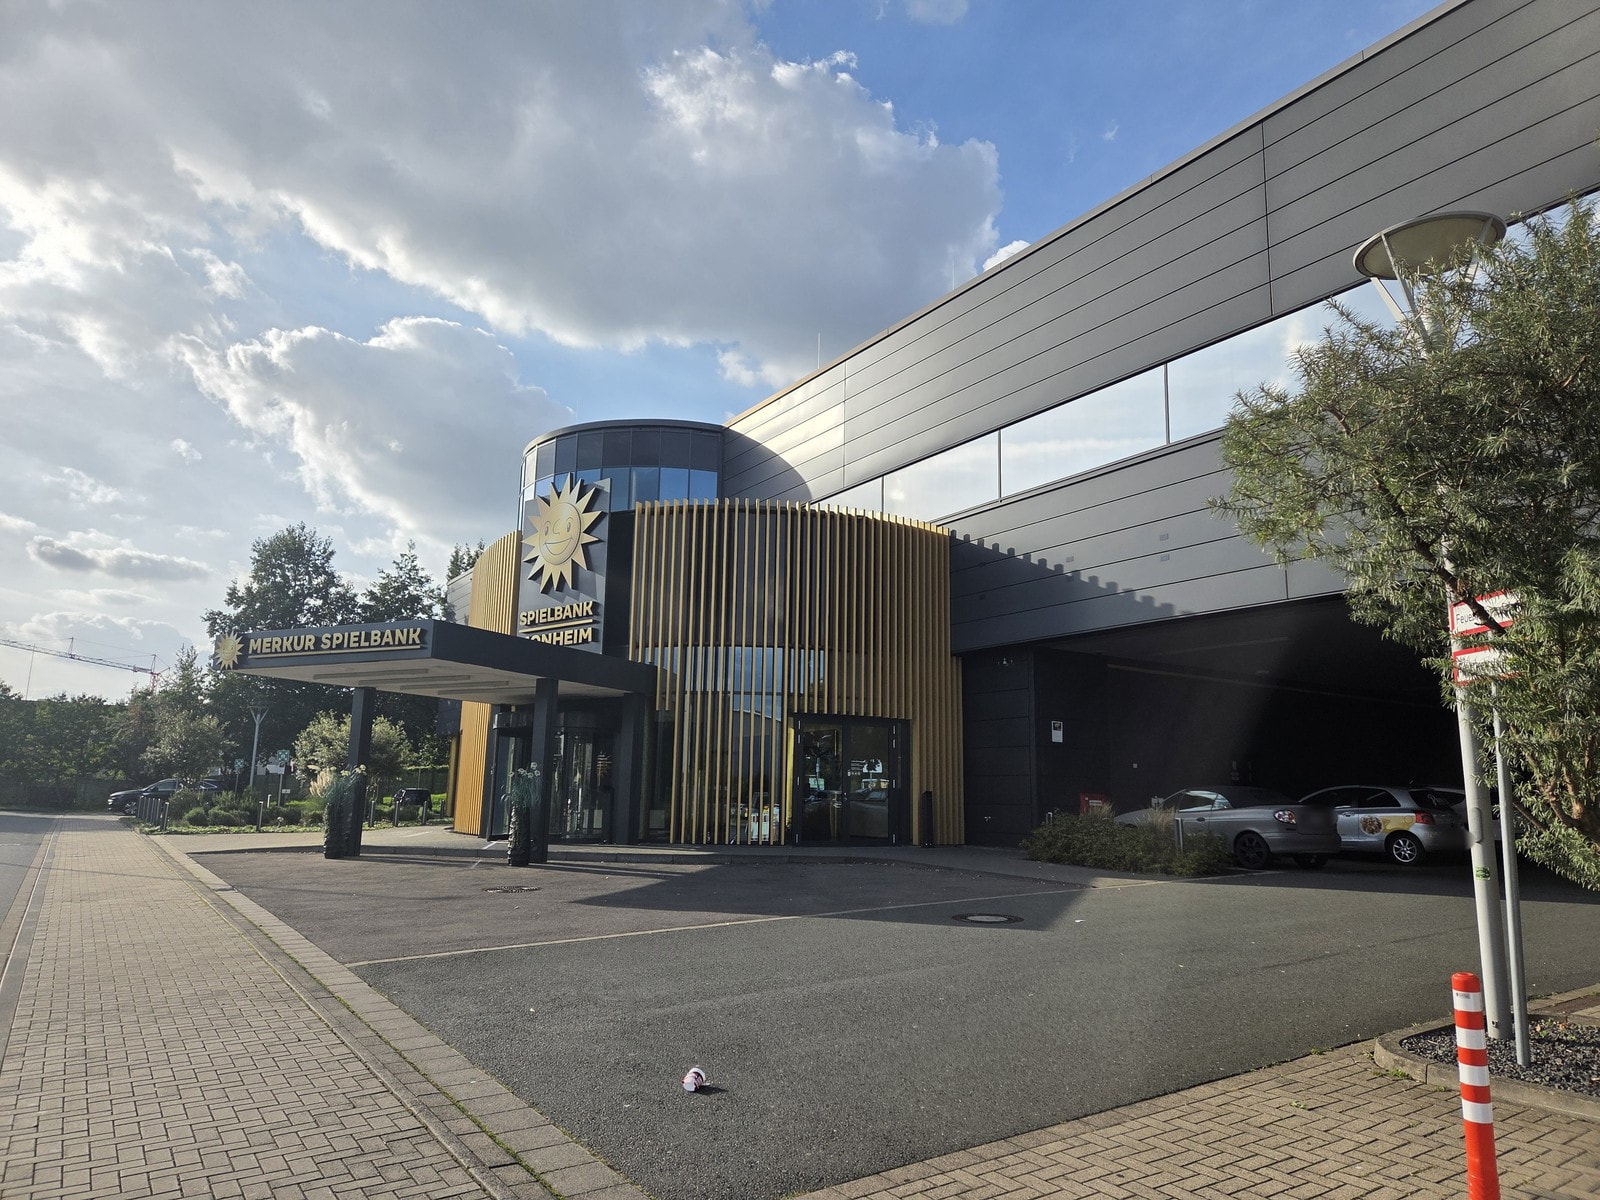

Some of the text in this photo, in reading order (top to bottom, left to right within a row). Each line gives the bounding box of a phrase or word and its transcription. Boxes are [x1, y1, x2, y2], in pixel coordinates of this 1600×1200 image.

[519, 600, 594, 626] SPIELBANK
[249, 627, 422, 654] MERKUR SPIELBANK
[524, 626, 593, 646] NHEIM
